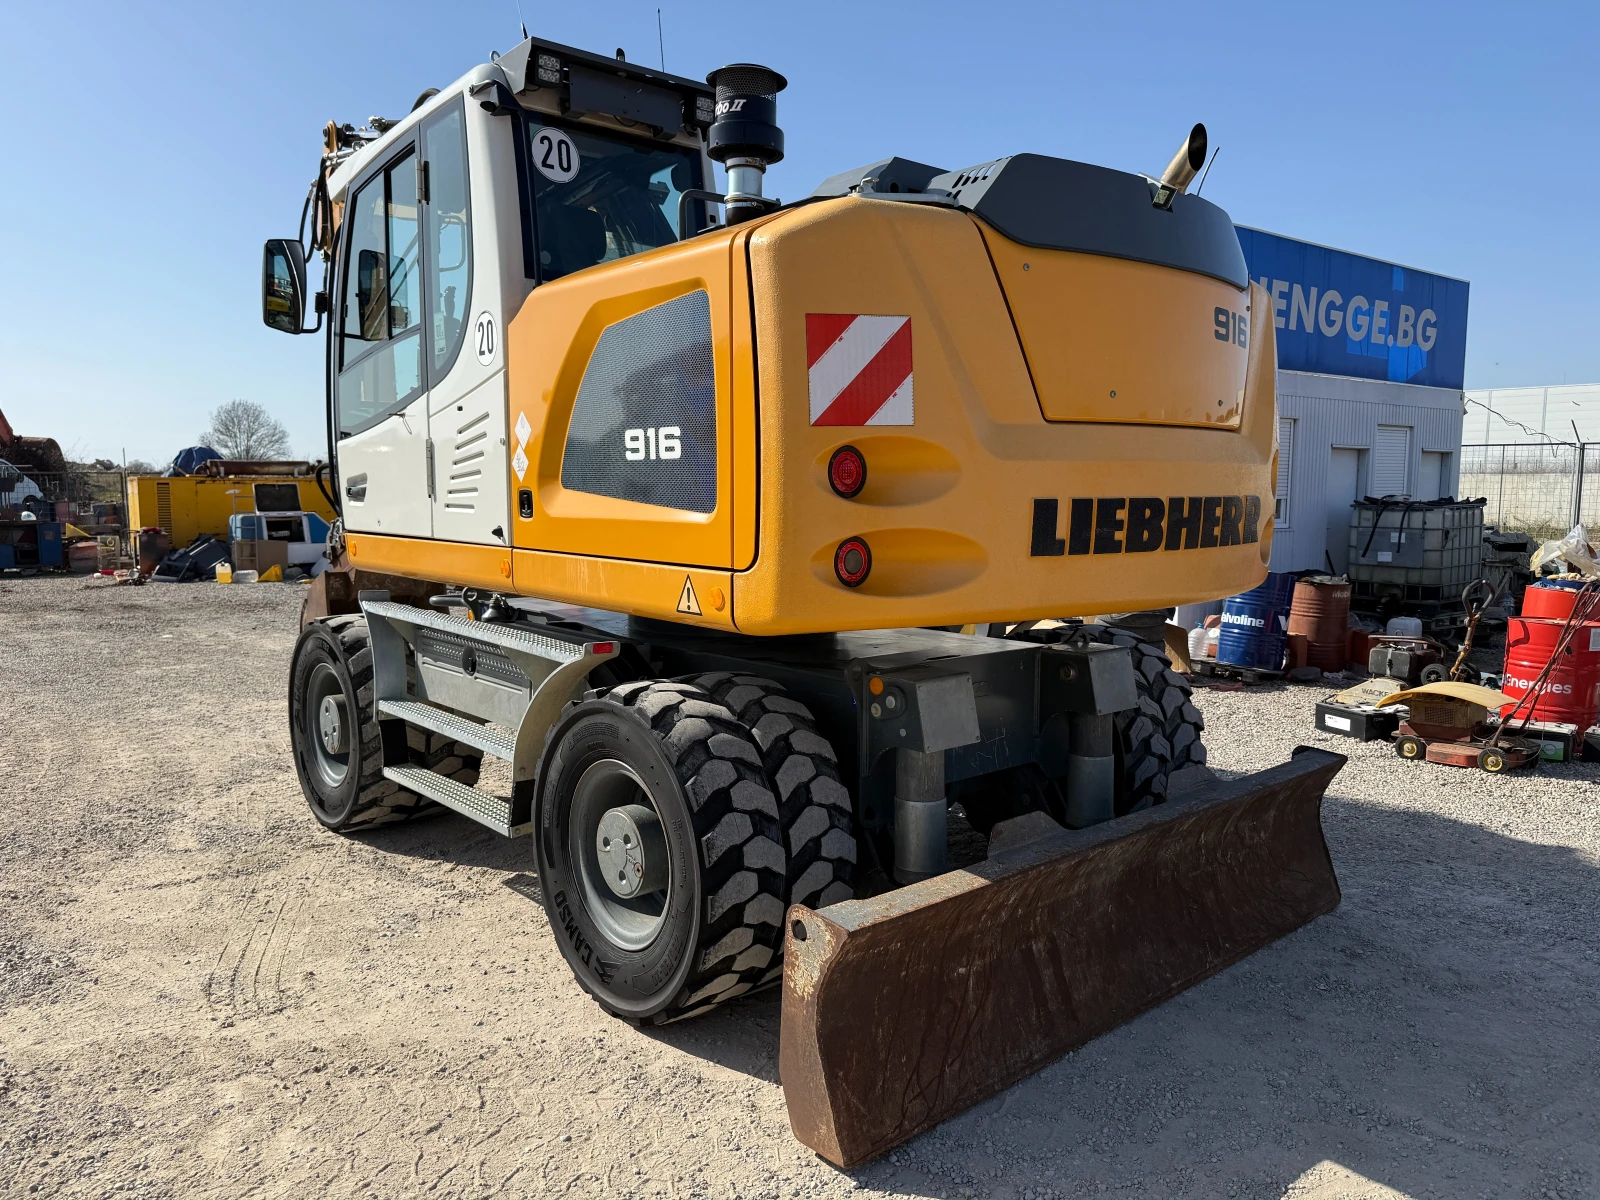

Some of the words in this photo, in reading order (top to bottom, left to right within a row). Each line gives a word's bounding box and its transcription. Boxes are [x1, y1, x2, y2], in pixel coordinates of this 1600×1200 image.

[540, 135, 571, 173] 20
[1214, 306, 1247, 349] 916
[1260, 276, 1437, 351] ENGGE.BG
[478, 320, 494, 356] 20
[625, 426, 682, 461] 916
[1030, 495, 1262, 557] LIEBHERR
[1221, 611, 1266, 628] alvoline
[1361, 688, 1392, 698] WACKE
[553, 889, 593, 968] CAMSO
